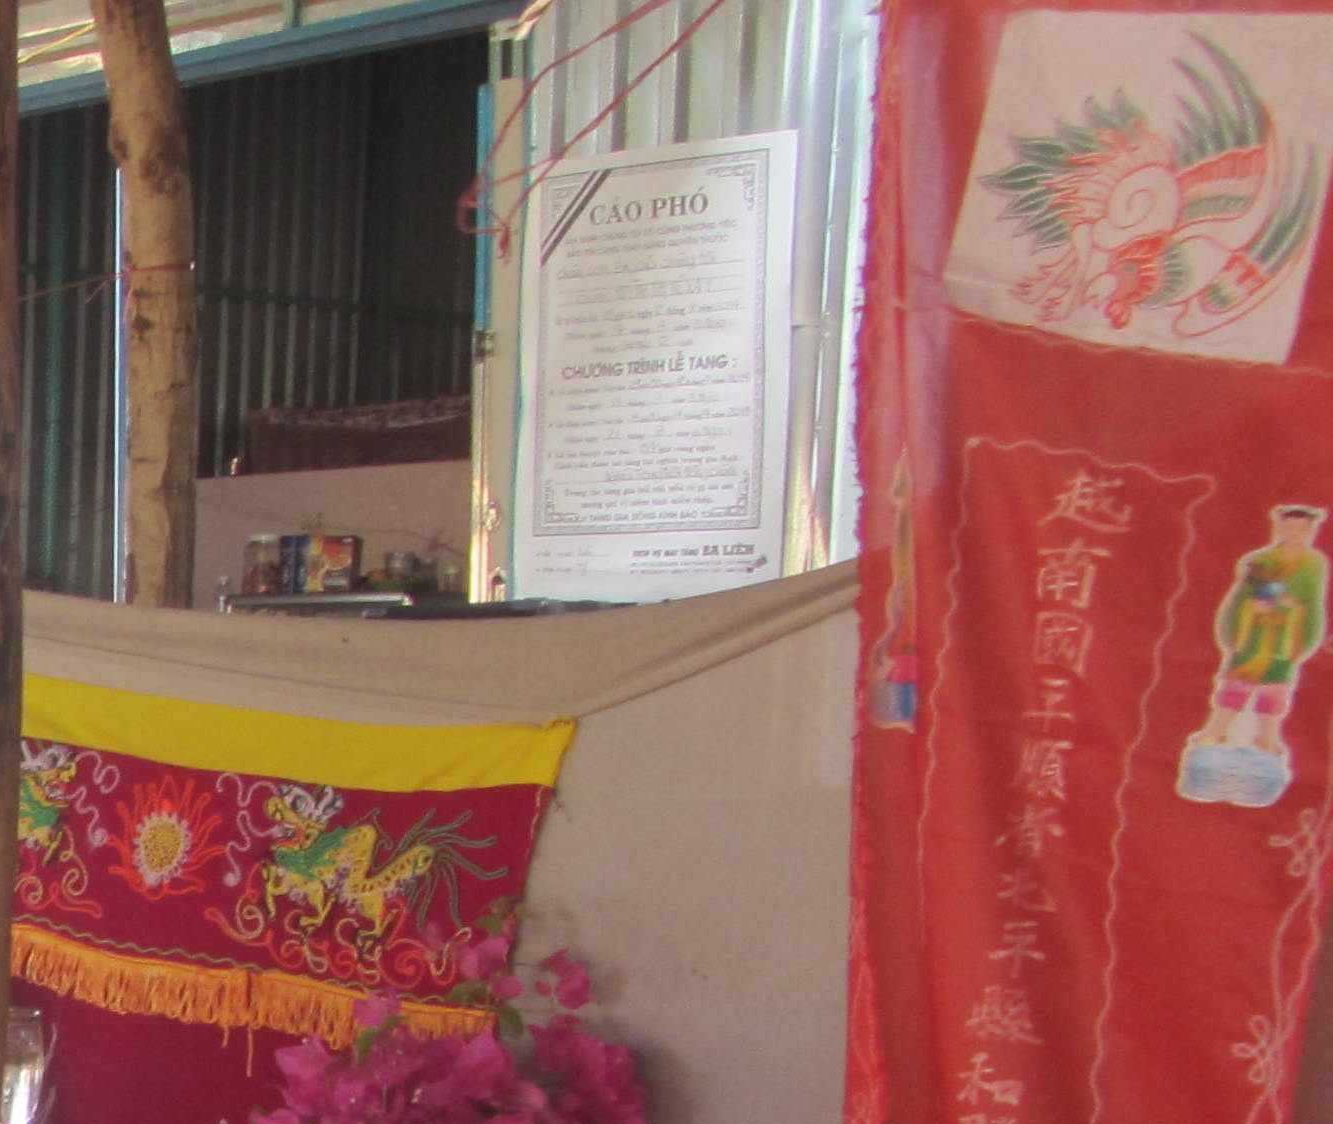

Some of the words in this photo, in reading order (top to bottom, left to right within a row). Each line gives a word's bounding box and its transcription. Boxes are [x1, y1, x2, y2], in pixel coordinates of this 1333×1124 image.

[588, 195, 643, 226] CÁO
[650, 186, 710, 219] PHÓ
[561, 361, 625, 380] CHƯƠNG
[627, 356, 666, 375] TRÌNH
[668, 350, 685, 373] LỄ
[688, 354, 730, 370] TANG
